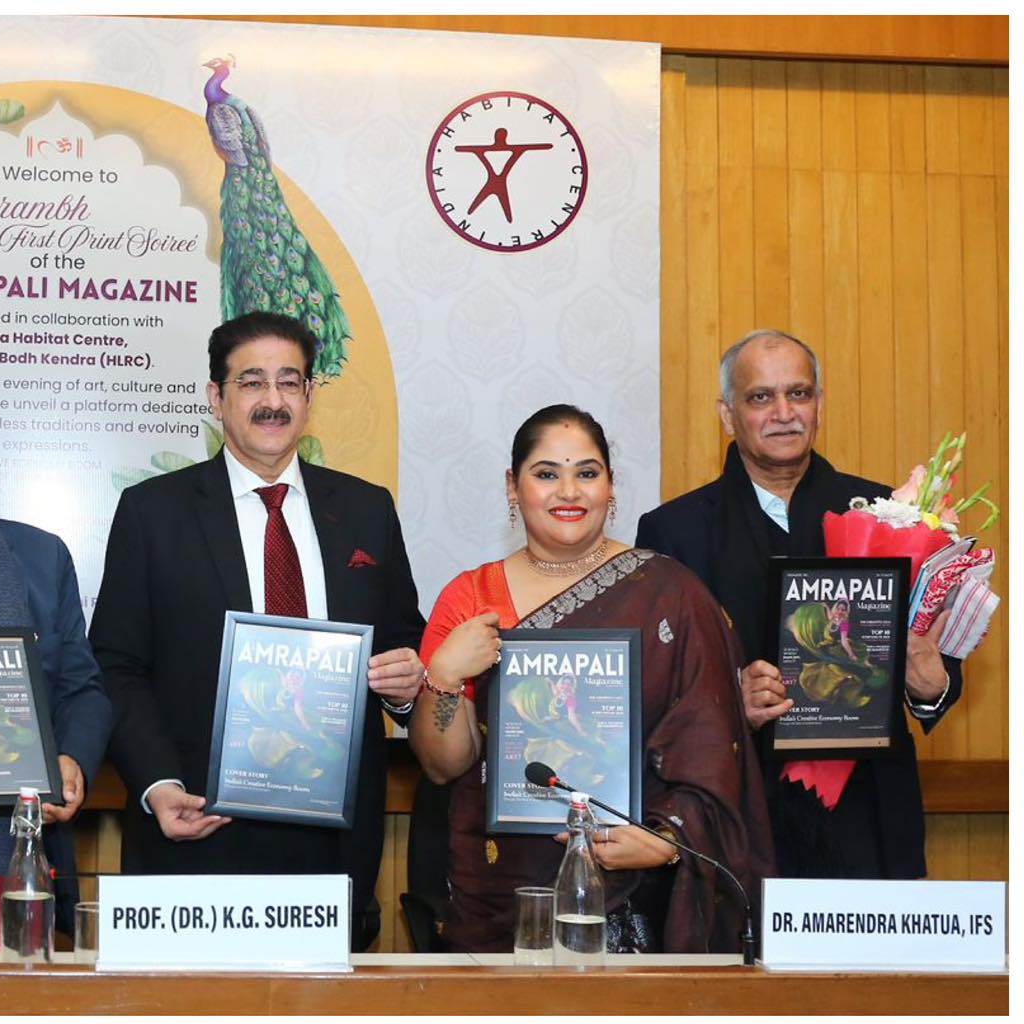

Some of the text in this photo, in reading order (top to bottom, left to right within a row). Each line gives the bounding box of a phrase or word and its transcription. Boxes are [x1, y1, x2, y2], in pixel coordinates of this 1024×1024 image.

[2, 166, 118, 184] Welcome to
[57, 225, 126, 253] Print
[30, 254, 86, 270] of the
[59, 278, 197, 303] MAGAZINE
[15, 312, 27, 324] in
[32, 313, 129, 327] collaboration
[133, 315, 164, 328] with
[13, 332, 69, 345] Habitat
[73, 334, 128, 348] Centre,
[0, 352, 37, 365] Bodh
[41, 353, 96, 366] Kendra
[100, 353, 155, 370] (HLRC).
[3, 379, 61, 393] evening
[66, 379, 81, 391] of
[84, 381, 108, 393] art,
[112, 381, 163, 393] culture
[167, 382, 196, 394] and
[13, 398, 56, 410] unveil
[61, 401, 70, 411] a
[75, 400, 138, 415] platform
[31, 420, 199, 437] traditions and evolving
[785, 578, 893, 601] AMRAPALI
[238, 641, 353, 673] AMRAPALI
[505, 653, 624, 676] AMRAPALI
[113, 905, 338, 933] PROF. (DR.) K.G. SURESH
[772, 912, 993, 937] DR. AMARENDRA KHATUA, IFS
